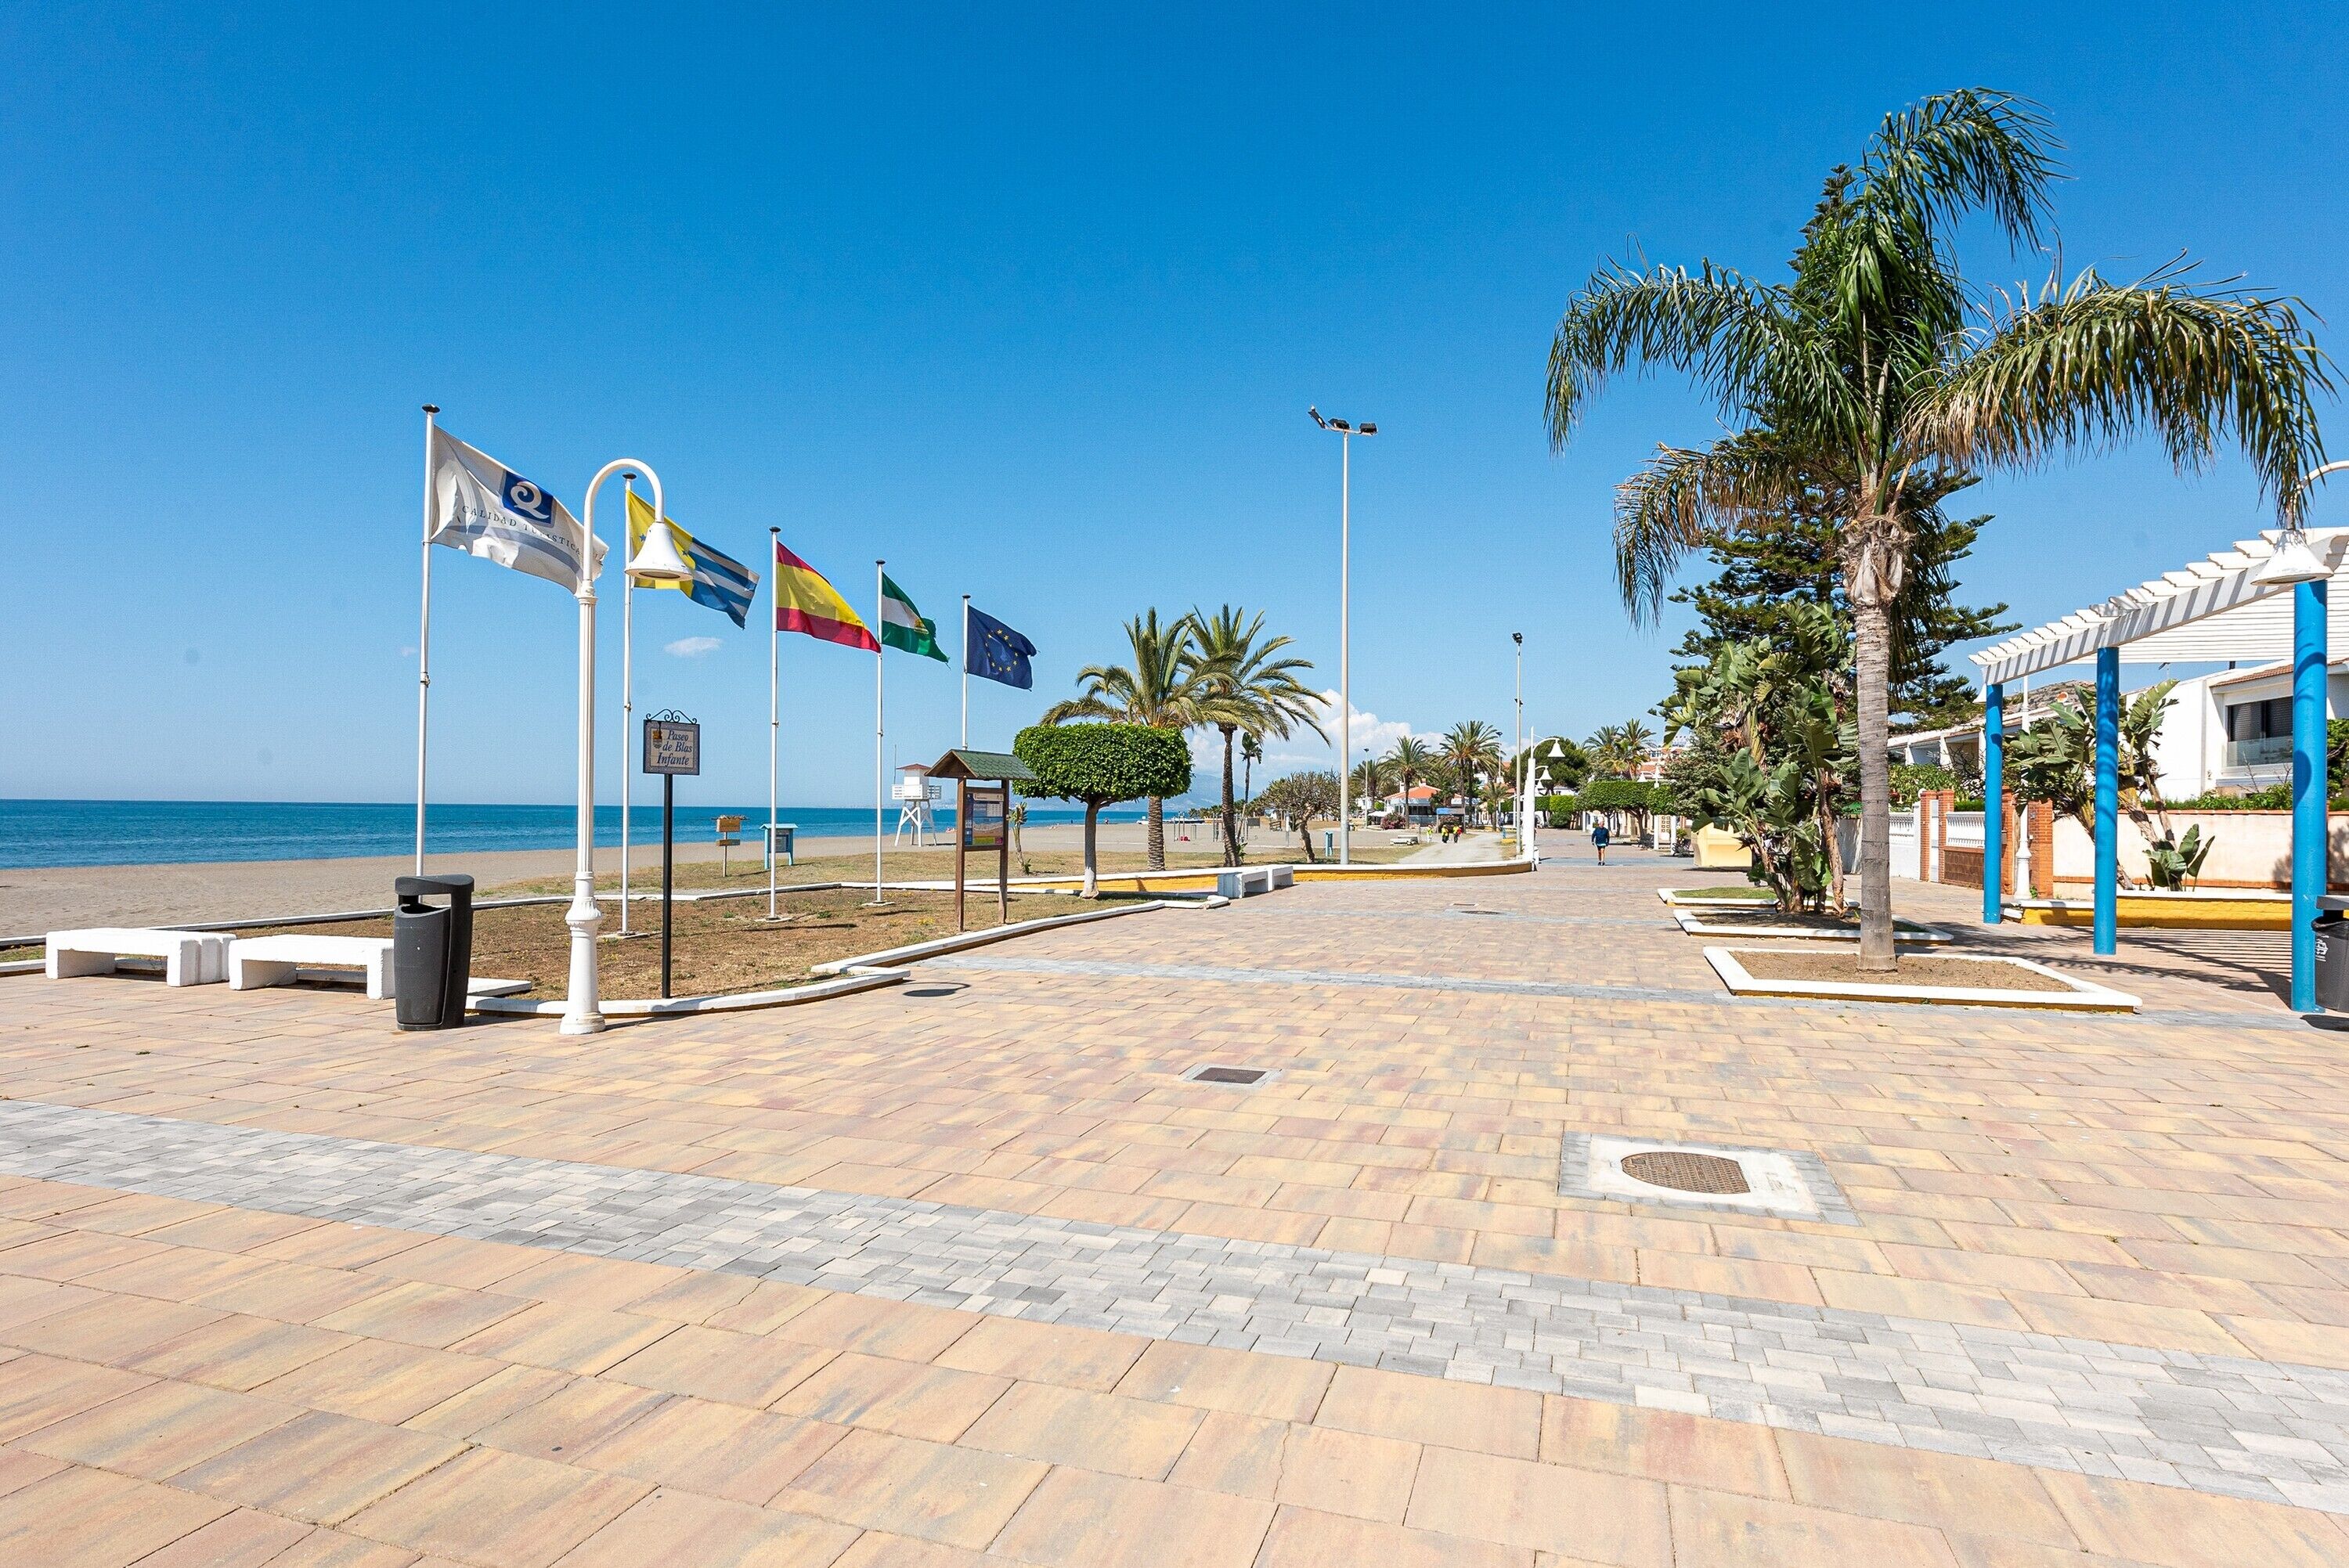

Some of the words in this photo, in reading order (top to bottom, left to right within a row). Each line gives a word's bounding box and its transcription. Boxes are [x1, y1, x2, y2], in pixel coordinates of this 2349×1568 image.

[510, 481, 550, 519] Q
[462, 506, 517, 527] CALIDAD
[523, 523, 580, 555] TUSTICA
[667, 730, 689, 741] Paseo
[662, 741, 673, 752] de
[674, 741, 693, 753] Blas
[656, 752, 690, 766] Infante
